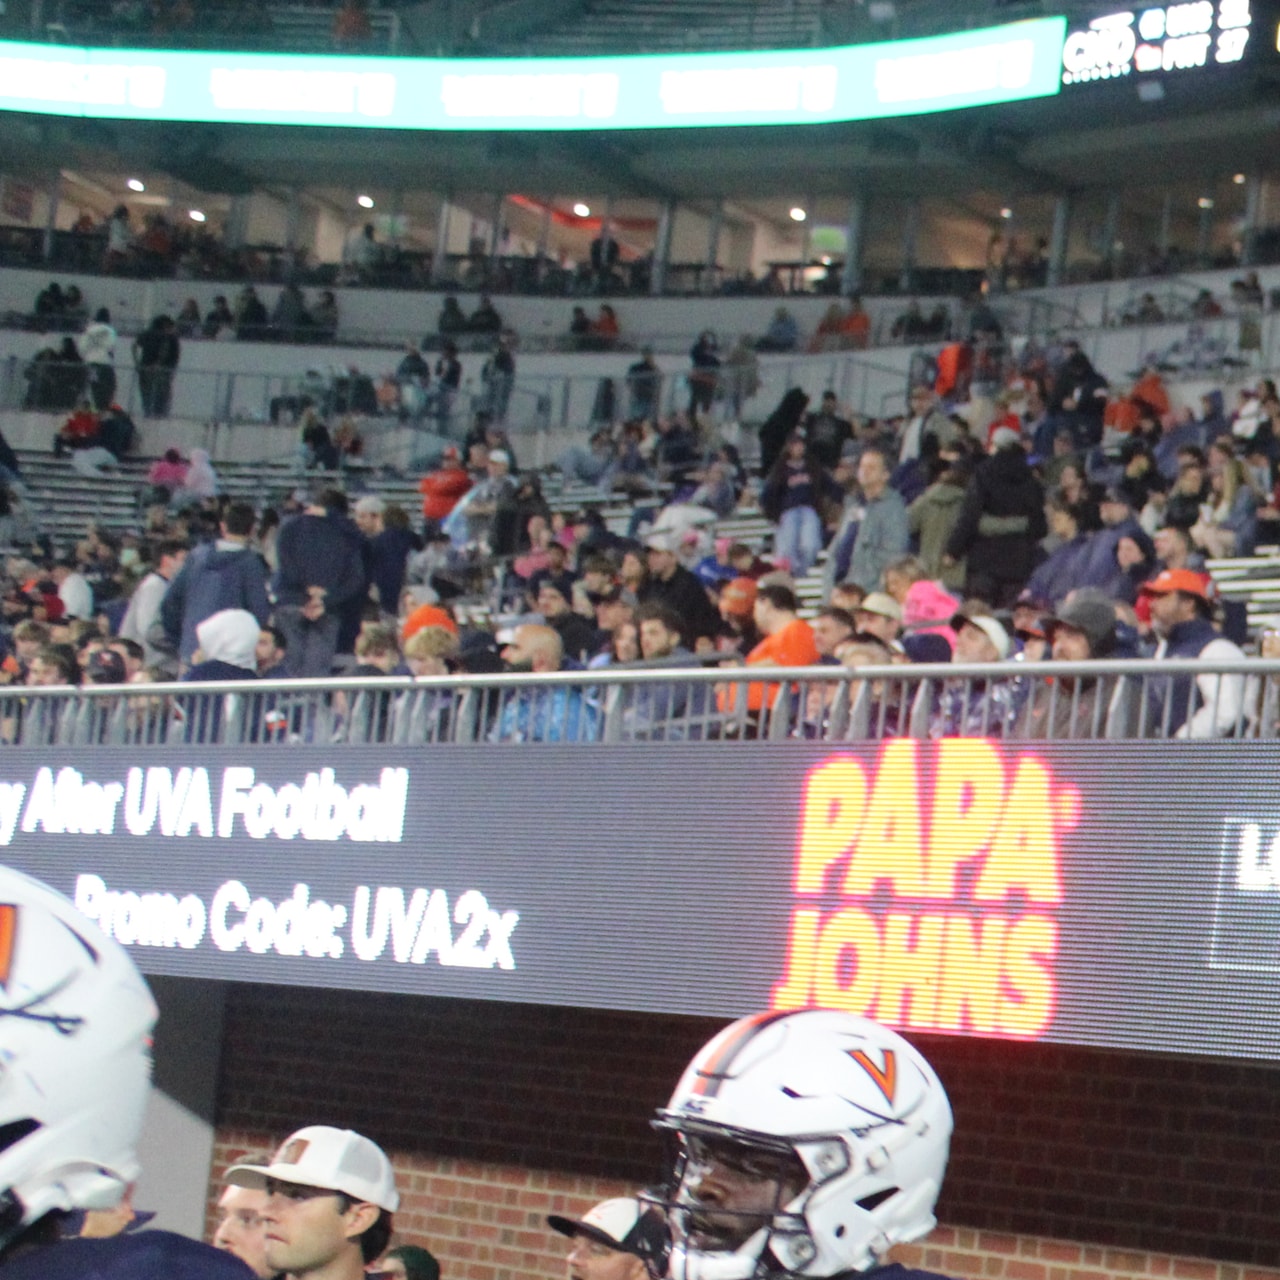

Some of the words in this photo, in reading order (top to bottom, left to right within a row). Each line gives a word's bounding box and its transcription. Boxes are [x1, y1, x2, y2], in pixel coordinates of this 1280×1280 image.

[22, 766, 124, 834] After
[125, 766, 213, 837] UVA
[218, 767, 409, 842] Football
[792, 737, 1065, 906] PAPA
[75, 874, 207, 949] Promo
[210, 880, 347, 959] Code:
[352, 885, 521, 970] UVA2x
[768, 903, 1061, 1042] JOHNS
